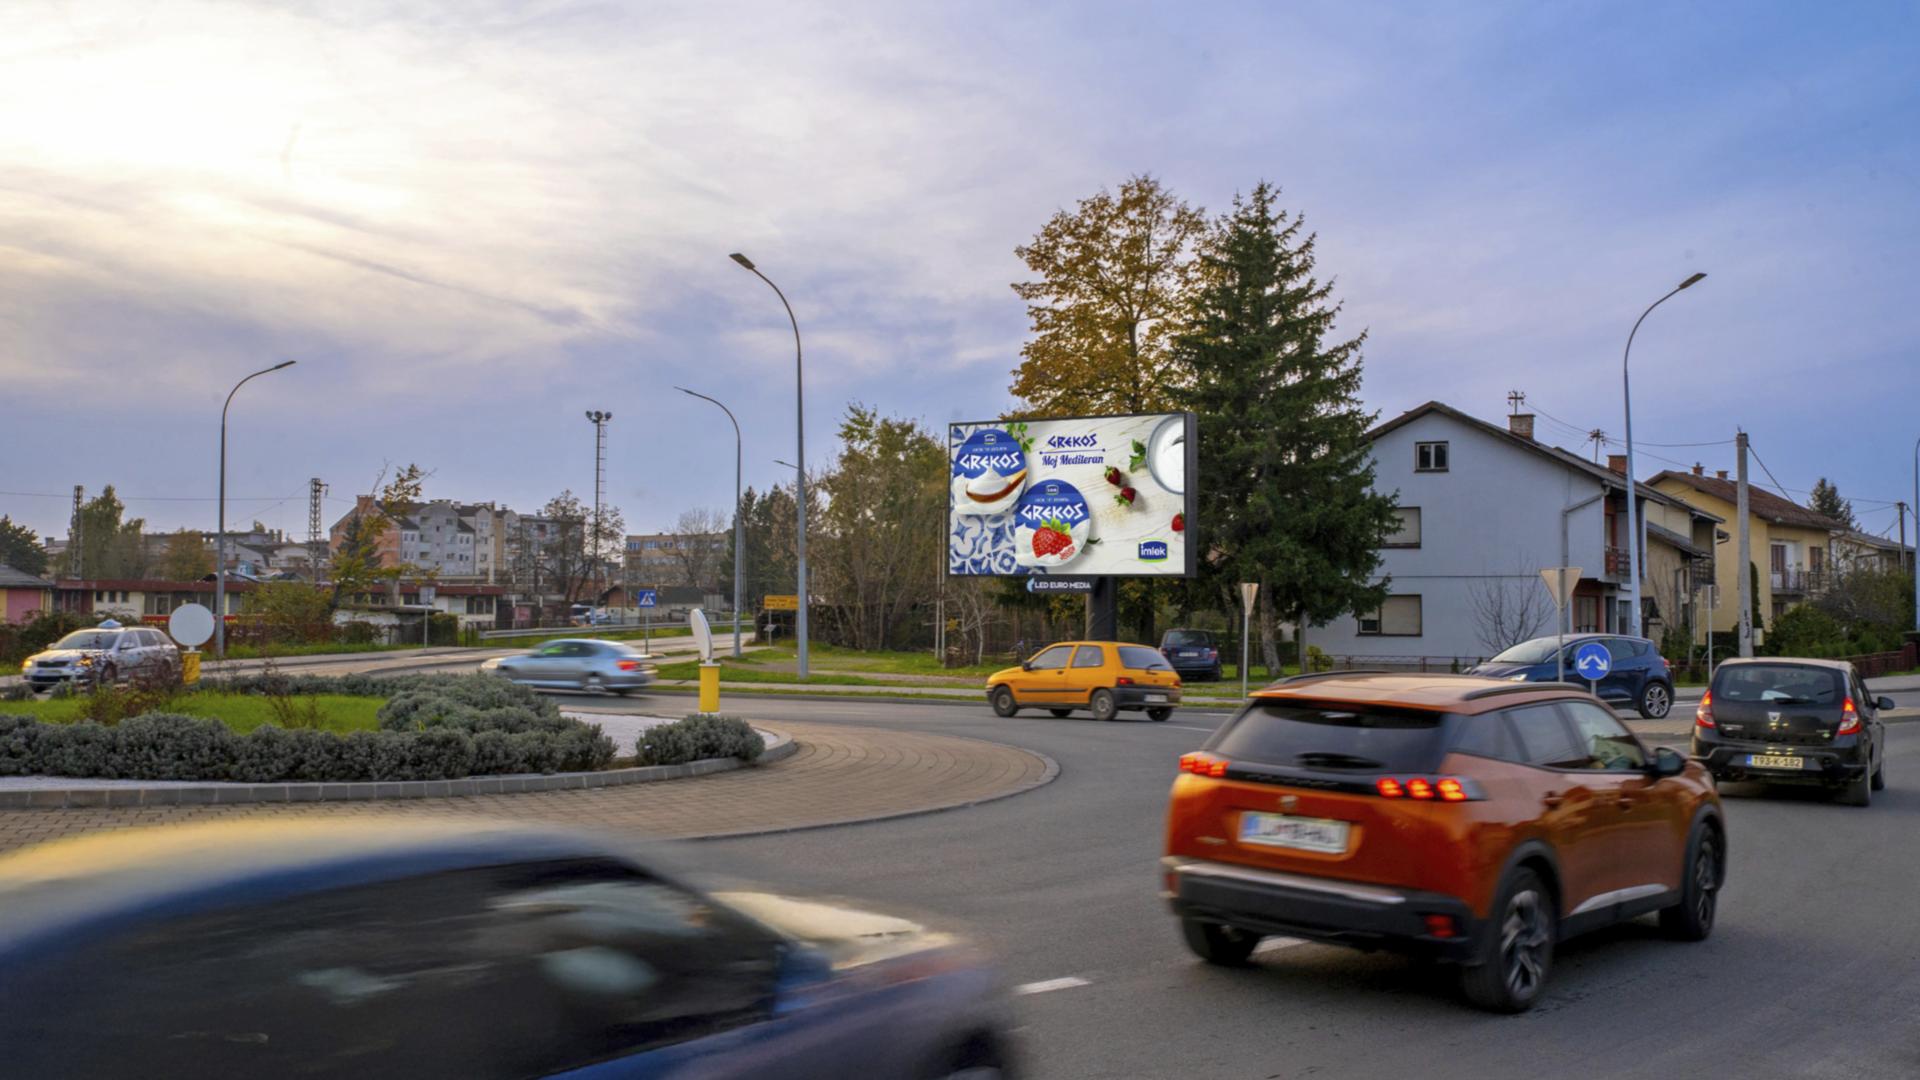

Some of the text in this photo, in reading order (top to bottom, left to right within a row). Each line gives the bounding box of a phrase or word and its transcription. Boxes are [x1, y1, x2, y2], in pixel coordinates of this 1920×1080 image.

[1048, 433, 1097, 448] GREKOS
[959, 451, 1020, 470] GREKOS
[1042, 454, 1104, 469] Moj Mediteran
[1020, 502, 1084, 520] GREKOS
[1034, 581, 1091, 589] LED EURO MEDIA
